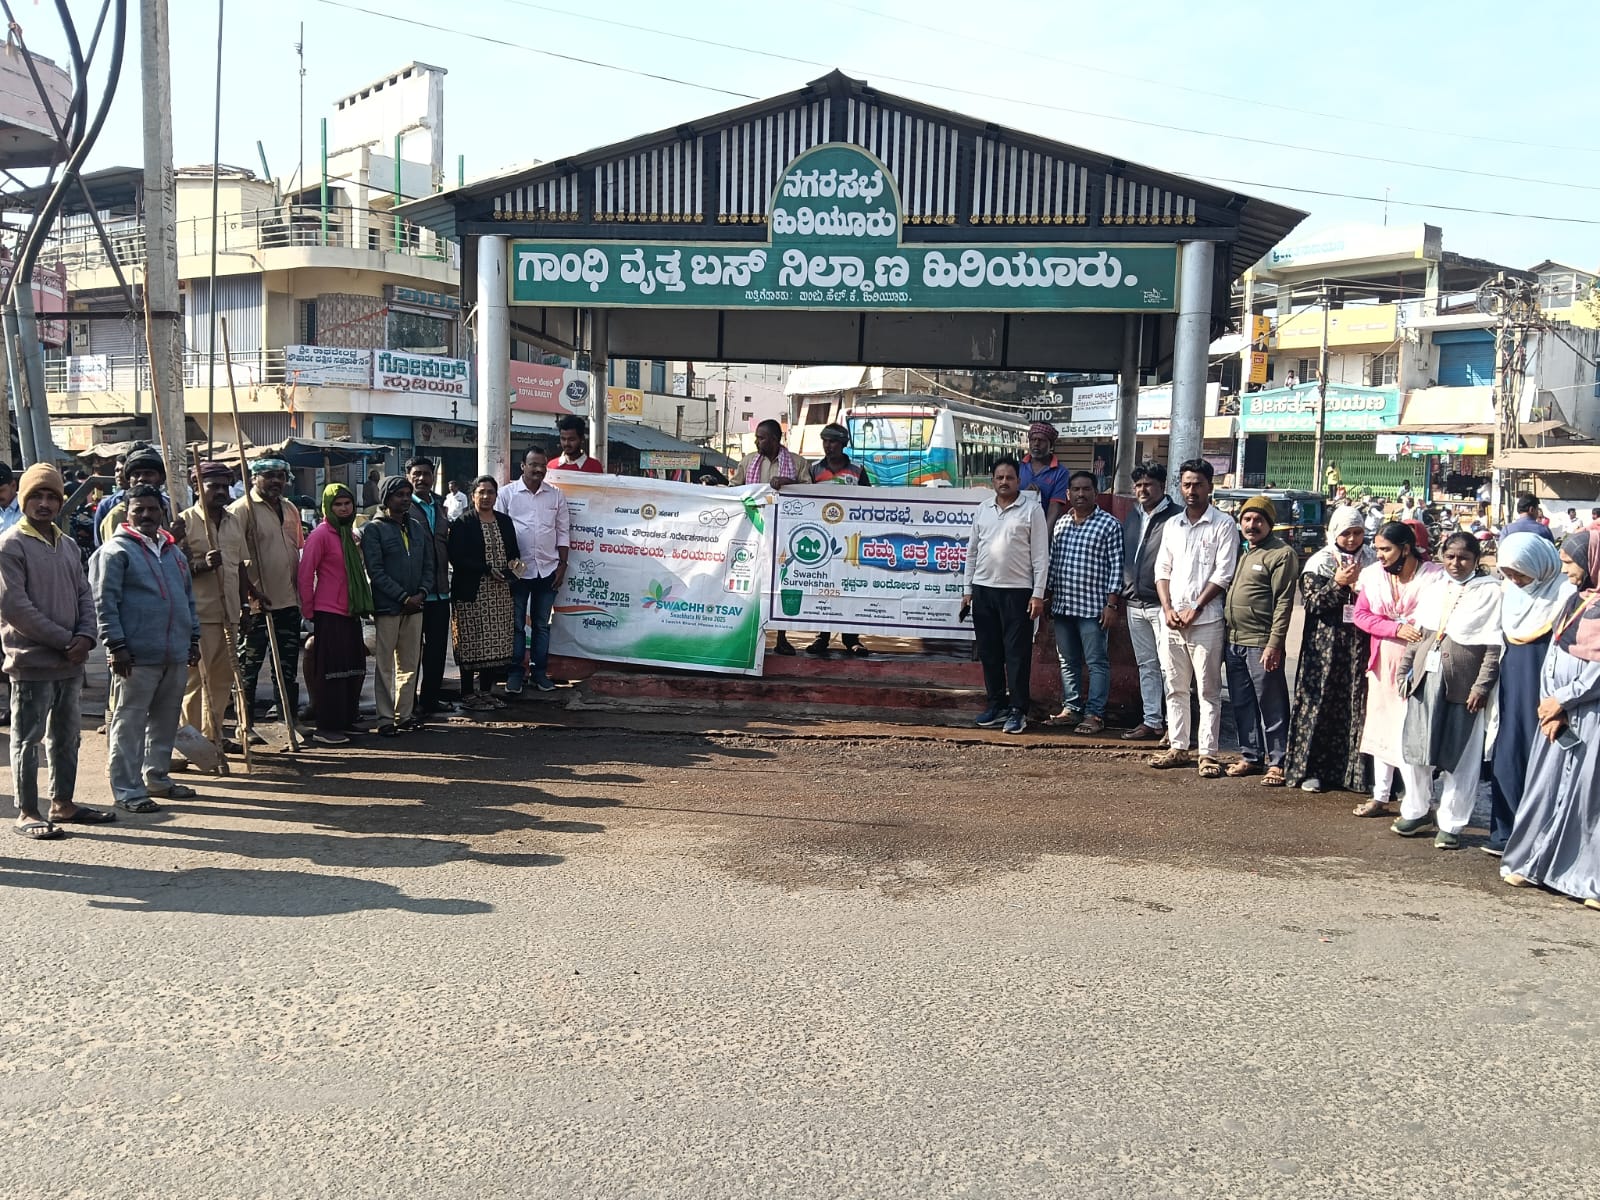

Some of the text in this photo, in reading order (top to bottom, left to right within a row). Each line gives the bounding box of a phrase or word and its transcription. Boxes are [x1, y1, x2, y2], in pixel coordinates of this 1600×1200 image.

[783, 168, 884, 204] ನಗರಸಭೆ
[773, 205, 897, 237] ಹಿರಿಯೂರು
[518, 249, 609, 293] ಗಾಂಧಿ
[620, 249, 686, 295] ವೃತ್ತ
[690, 249, 768, 287] ಬಸ್
[922, 250, 1138, 288] ಹಿರಿಯೂರು.
[569, 540, 595, 553] ರಸಭೆ
[863, 541, 895, 565] ನಮ್ಮ
[792, 569, 828, 580] Swachh
[782, 577, 835, 593] Survekshan
[817, 588, 841, 598] 2025
[609, 591, 630, 602] 2025
